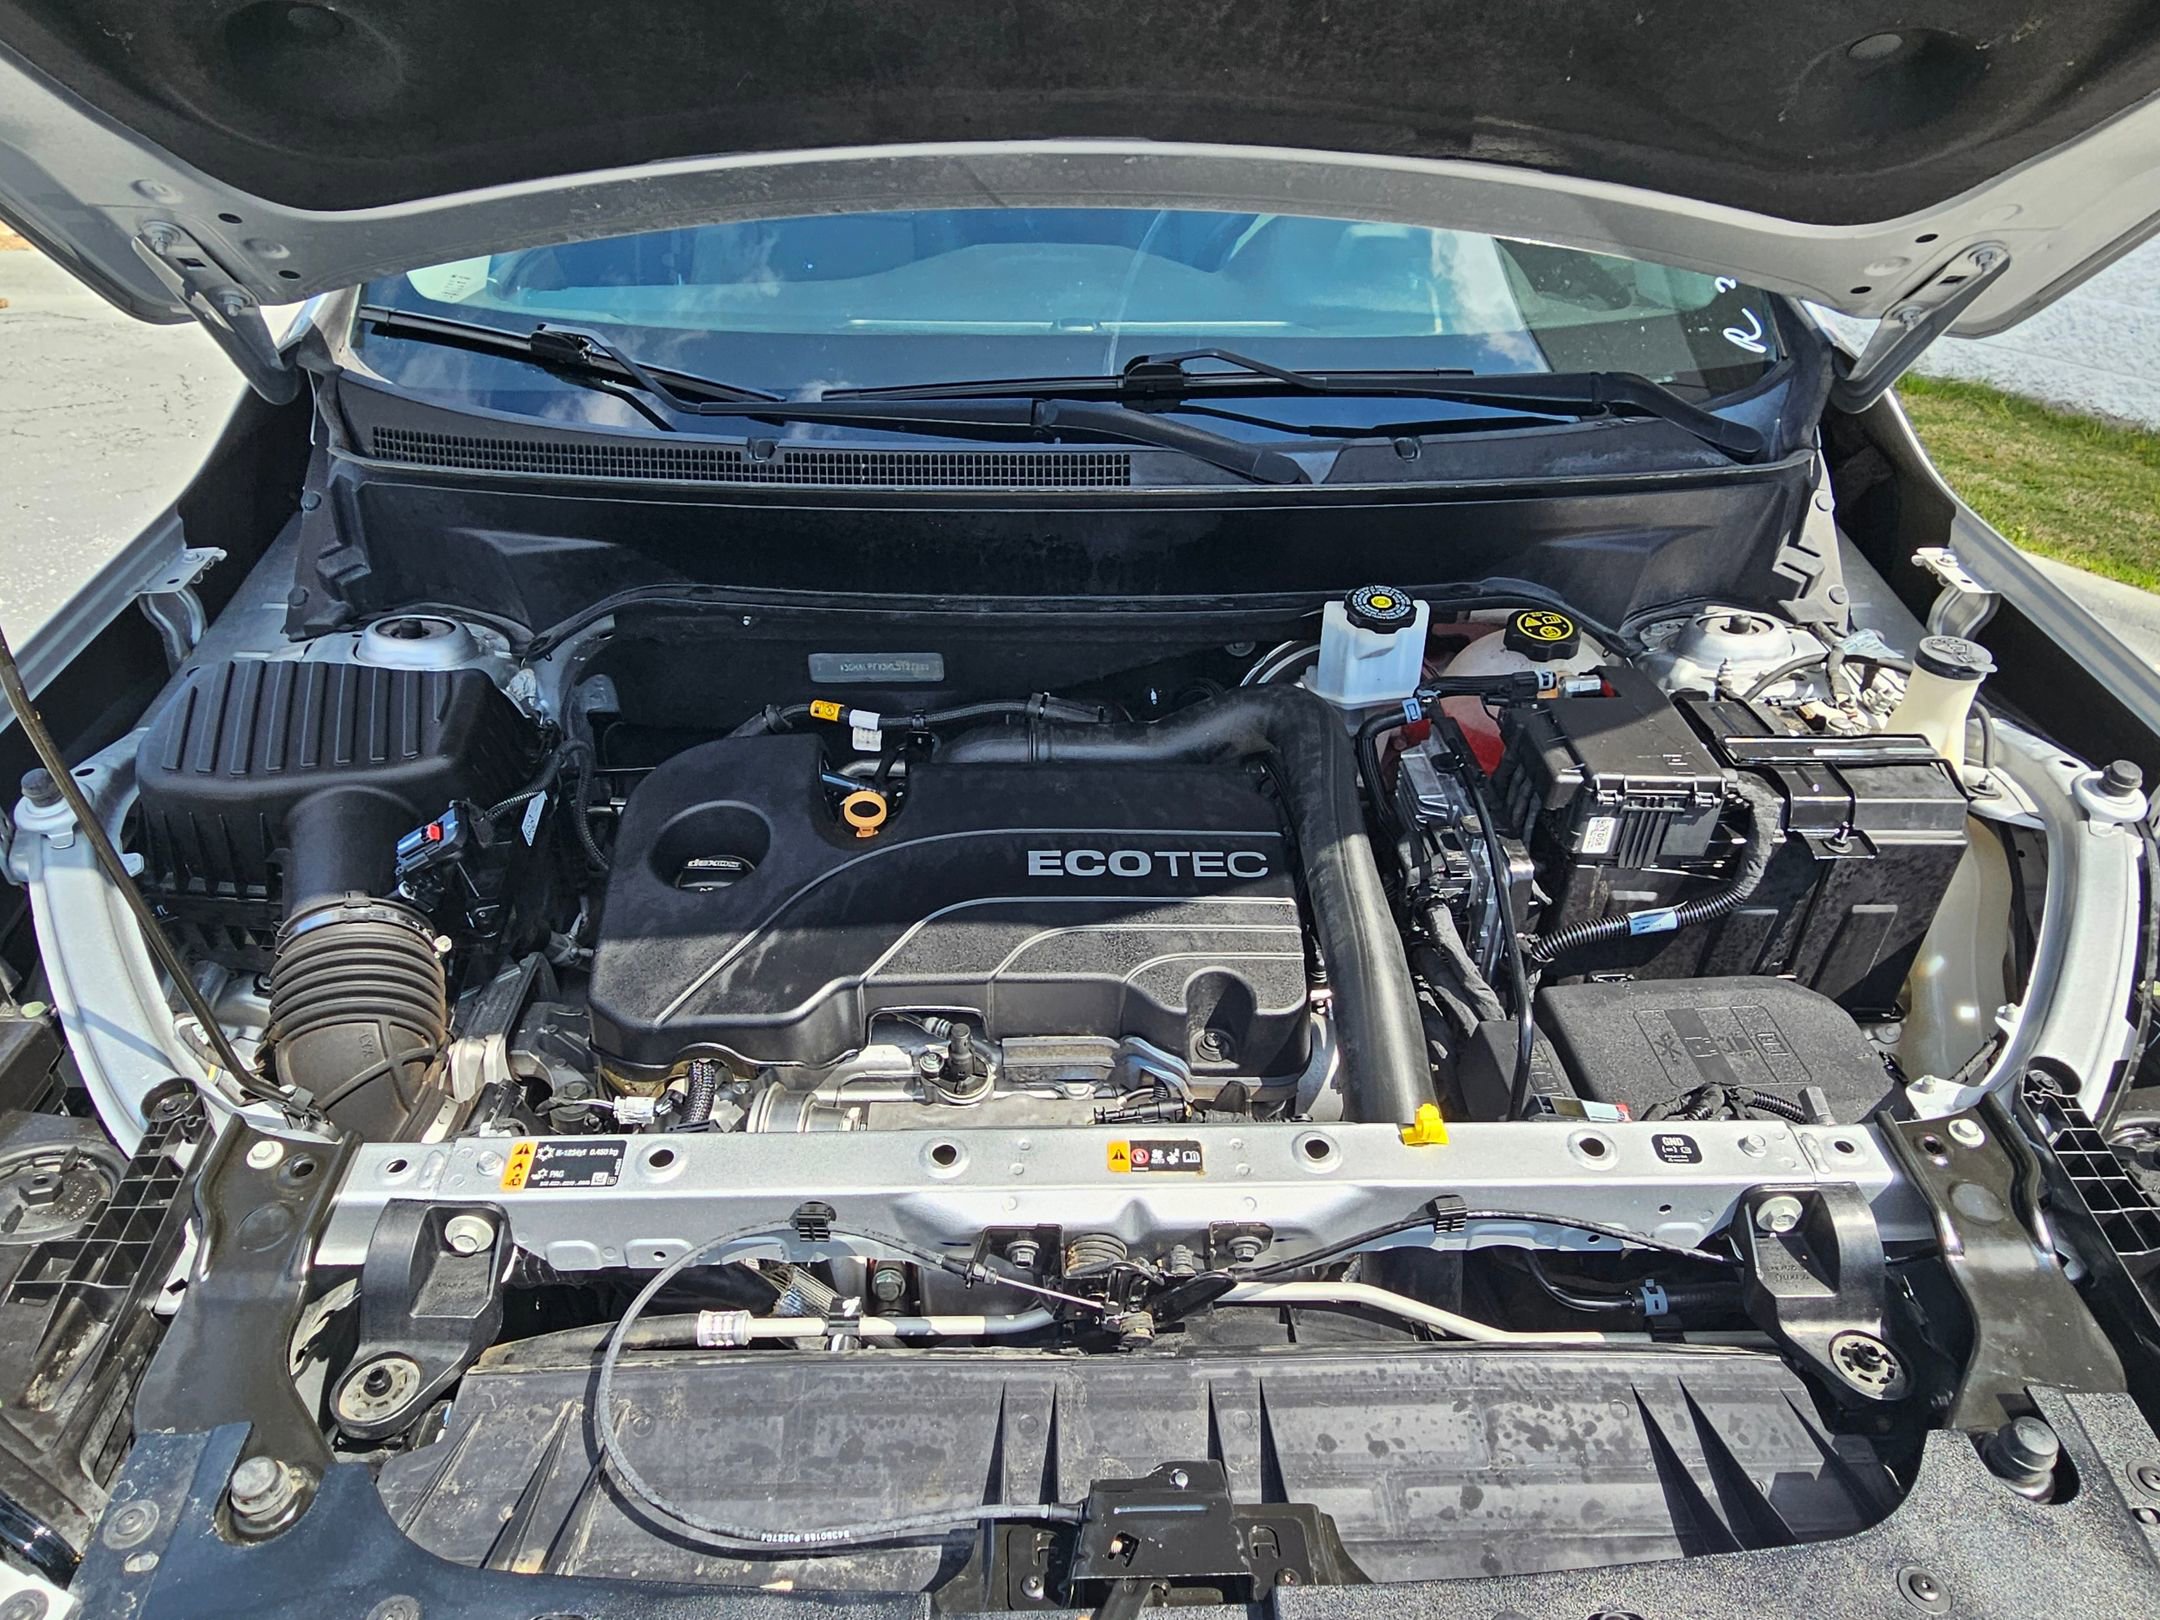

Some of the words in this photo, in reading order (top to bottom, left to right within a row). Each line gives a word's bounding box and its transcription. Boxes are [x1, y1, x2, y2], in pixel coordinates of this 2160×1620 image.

[1027, 849, 1269, 878] ECOTEC
[1661, 1136, 1685, 1147] GND
[549, 1170, 565, 1178] PAG
